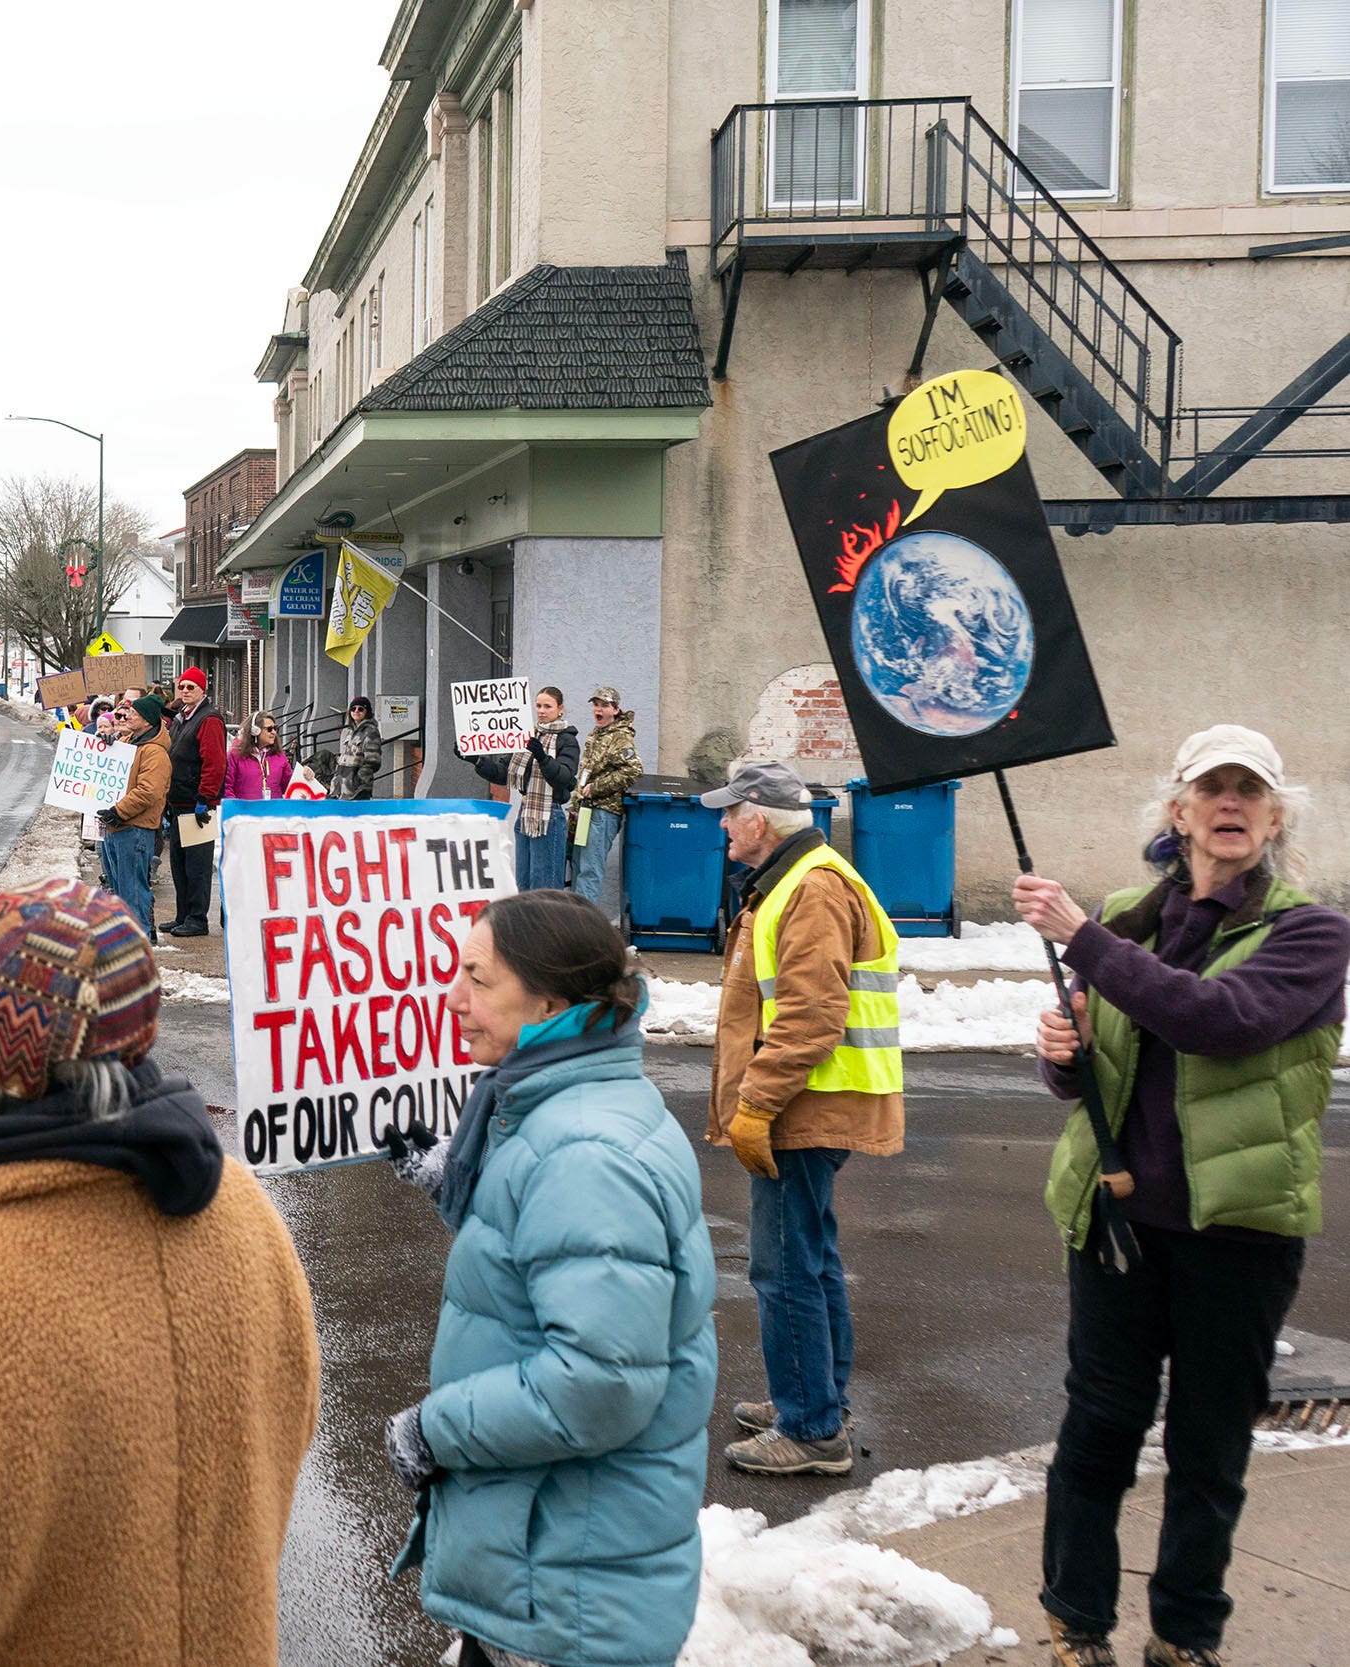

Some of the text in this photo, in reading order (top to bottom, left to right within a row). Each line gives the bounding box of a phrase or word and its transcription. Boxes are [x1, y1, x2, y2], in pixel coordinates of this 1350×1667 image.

[925, 379, 971, 421] I'M
[86, 665, 139, 682] CORRUPT
[453, 681, 528, 707] DIVERSITY
[468, 716, 523, 732] IS OUR
[459, 731, 532, 753] STRENGTH
[54, 760, 127, 790] NUESTROS
[53, 776, 121, 804] VECINOS!
[261, 827, 496, 911] FIGHT THE
[244, 1102, 288, 1166] OF
[293, 1092, 359, 1164] OUR
